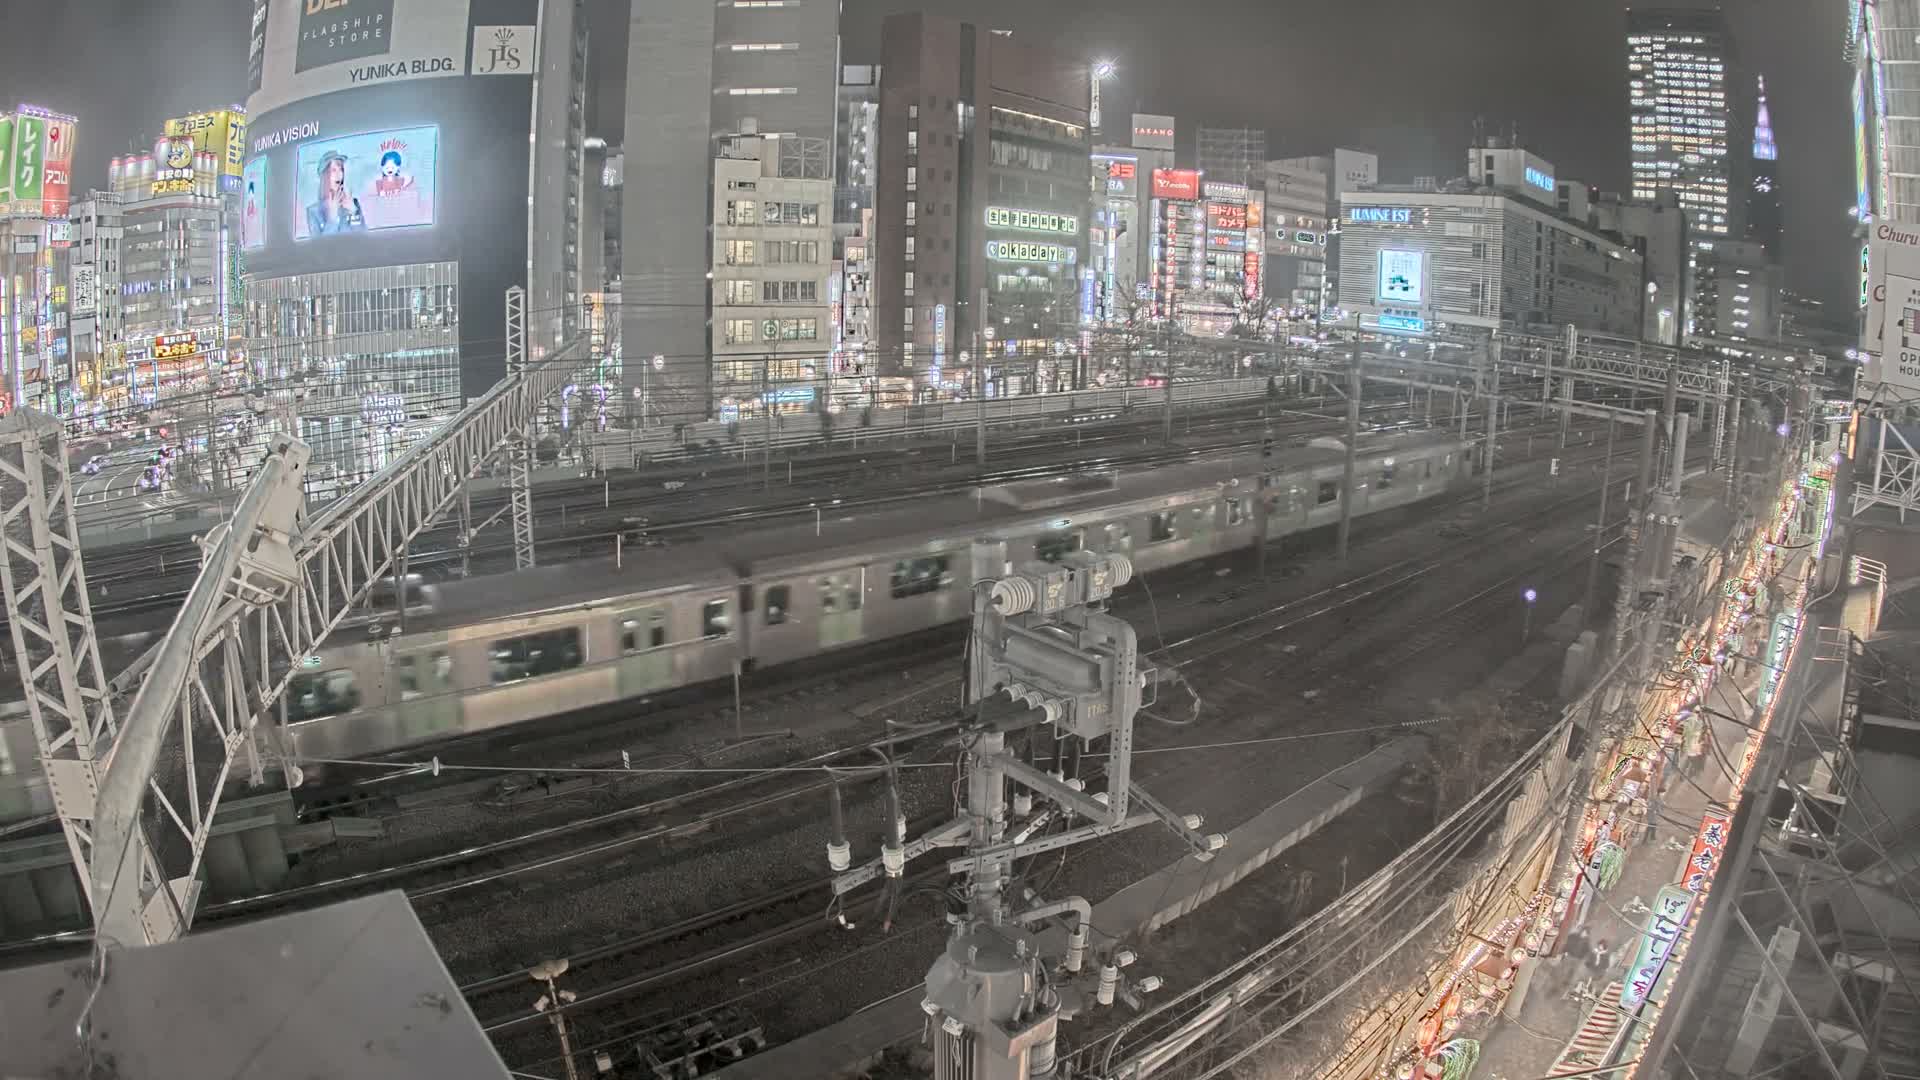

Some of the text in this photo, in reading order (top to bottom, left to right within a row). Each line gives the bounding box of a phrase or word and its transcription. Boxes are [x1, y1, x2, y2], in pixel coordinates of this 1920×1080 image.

[303, 14, 383, 41] FLAGSHIP
[328, 28, 382, 48] STORE
[349, 57, 456, 83] YUNIKA BLDG.
[254, 120, 320, 153] YUNIKA VISION
[1134, 127, 1174, 137] TAKANO
[21, 120, 38, 188] レイク
[45, 168, 69, 185] アコム
[1207, 205, 1246, 217] ヨドバシ
[1351, 208, 1409, 222] LUMINE EST
[1217, 217, 1246, 228] カメラ
[1876, 224, 1919, 246] Churu
[1000, 245, 1065, 262] okadaya
[1900, 351, 1920, 366] OP
[364, 395, 404, 407] Alpen
[363, 409, 405, 423] TOKYO
